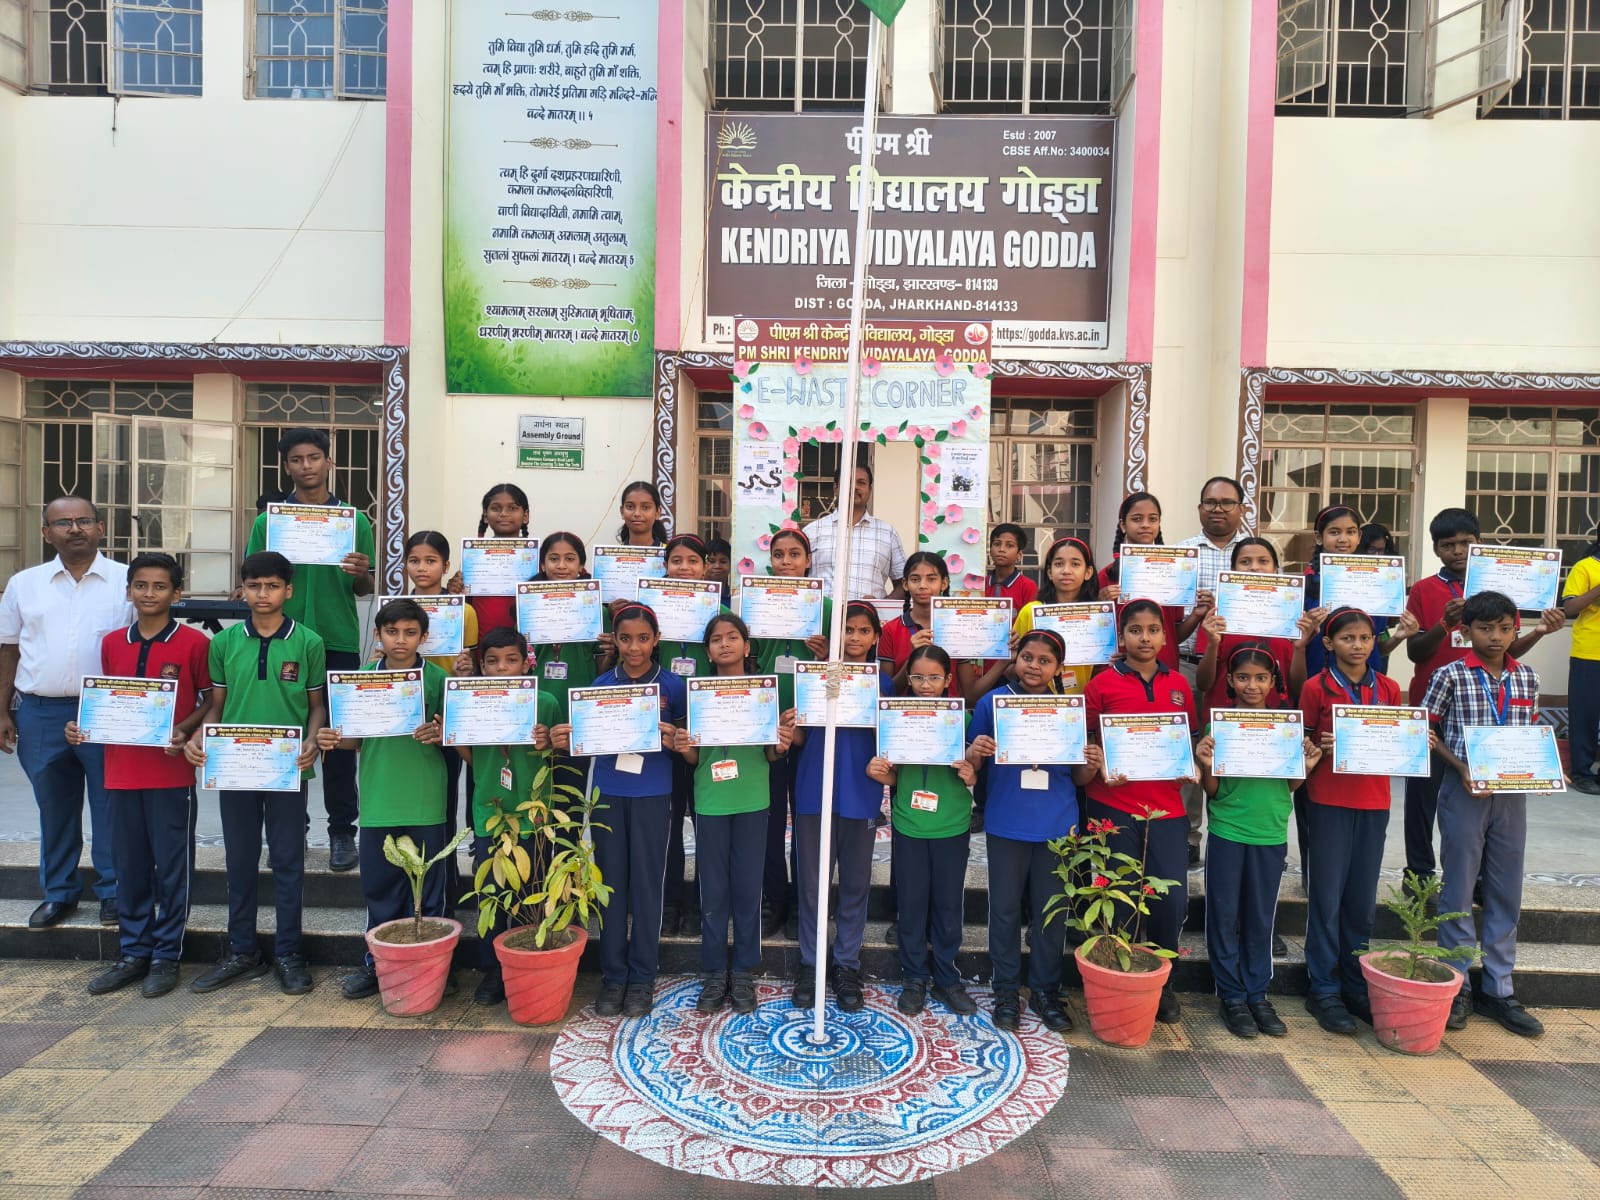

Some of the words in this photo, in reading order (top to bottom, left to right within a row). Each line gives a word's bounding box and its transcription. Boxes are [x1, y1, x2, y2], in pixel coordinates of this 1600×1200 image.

[488, 38, 505, 55] तुमि
[507, 39, 525, 53] विद्या
[528, 40, 544, 56] तुमि
[565, 40, 582, 58] तुमि
[602, 42, 618, 59] तुमि
[482, 64, 500, 78] त्वम्
[503, 61, 512, 75] हि
[589, 63, 605, 81] तुमि
[476, 82, 492, 99] तुमि
[562, 85, 588, 100] प्रतिमा
[527, 106, 546, 120] वन्दे
[548, 108, 577, 124] मातरम्
[905, 128, 932, 156] श्री
[1003, 130, 1025, 140] Estd
[1034, 131, 1057, 140] 2007
[1002, 146, 1030, 156] CBSE
[1034, 146, 1067, 156] Aff.No:
[1070, 147, 1110, 156] 3400034
[500, 167, 518, 183] त्वम्
[520, 165, 528, 179] हि
[531, 166, 548, 184] दुर्गा
[507, 184, 534, 196] कमला
[718, 164, 836, 212] केन्द्रीय
[1000, 167, 1102, 224] गोड्डा
[498, 203, 518, 217] वाणी
[572, 206, 599, 220] नमामि
[492, 225, 519, 239] नमामि
[521, 229, 555, 244] कमलाम्
[557, 230, 592, 245] अमलाम्
[720, 227, 850, 265] KENDRIYA
[1003, 230, 1097, 268] GODDA
[542, 250, 571, 267] मातरम्
[579, 250, 597, 265] वन्दे
[599, 253, 628, 269] मातरम्
[816, 274, 847, 290] जिला
[965, 279, 998, 291] 814133
[486, 304, 526, 320] श्यामलाम्
[528, 306, 559, 321] सरलाम्
[795, 298, 825, 309] DIST
[836, 298, 886, 312] GODA,
[890, 299, 1018, 312] JHARKHAND-814133
[544, 329, 574, 343] मातरम्
[580, 327, 598, 341] वन्दे
[599, 330, 630, 344] मातरम्
[713, 323, 724, 335] Ph
[769, 322, 801, 341] पीएम
[803, 323, 818, 340] श्री
[820, 323, 852, 342] केन्द्री
[865, 324, 916, 343] विद्यालय,
[919, 325, 956, 346] गोड्डा
[996, 327, 1100, 342] https://godda.kvs.ac.in
[738, 346, 756, 359] PM
[760, 346, 790, 360] SHRI
[794, 346, 850, 360] KENDRIY
[944, 348, 987, 362] GODDA
[757, 377, 848, 408] E-WAST
[872, 378, 968, 408] CORNER
[522, 431, 554, 440] Assembly
[556, 432, 580, 440] Ground
